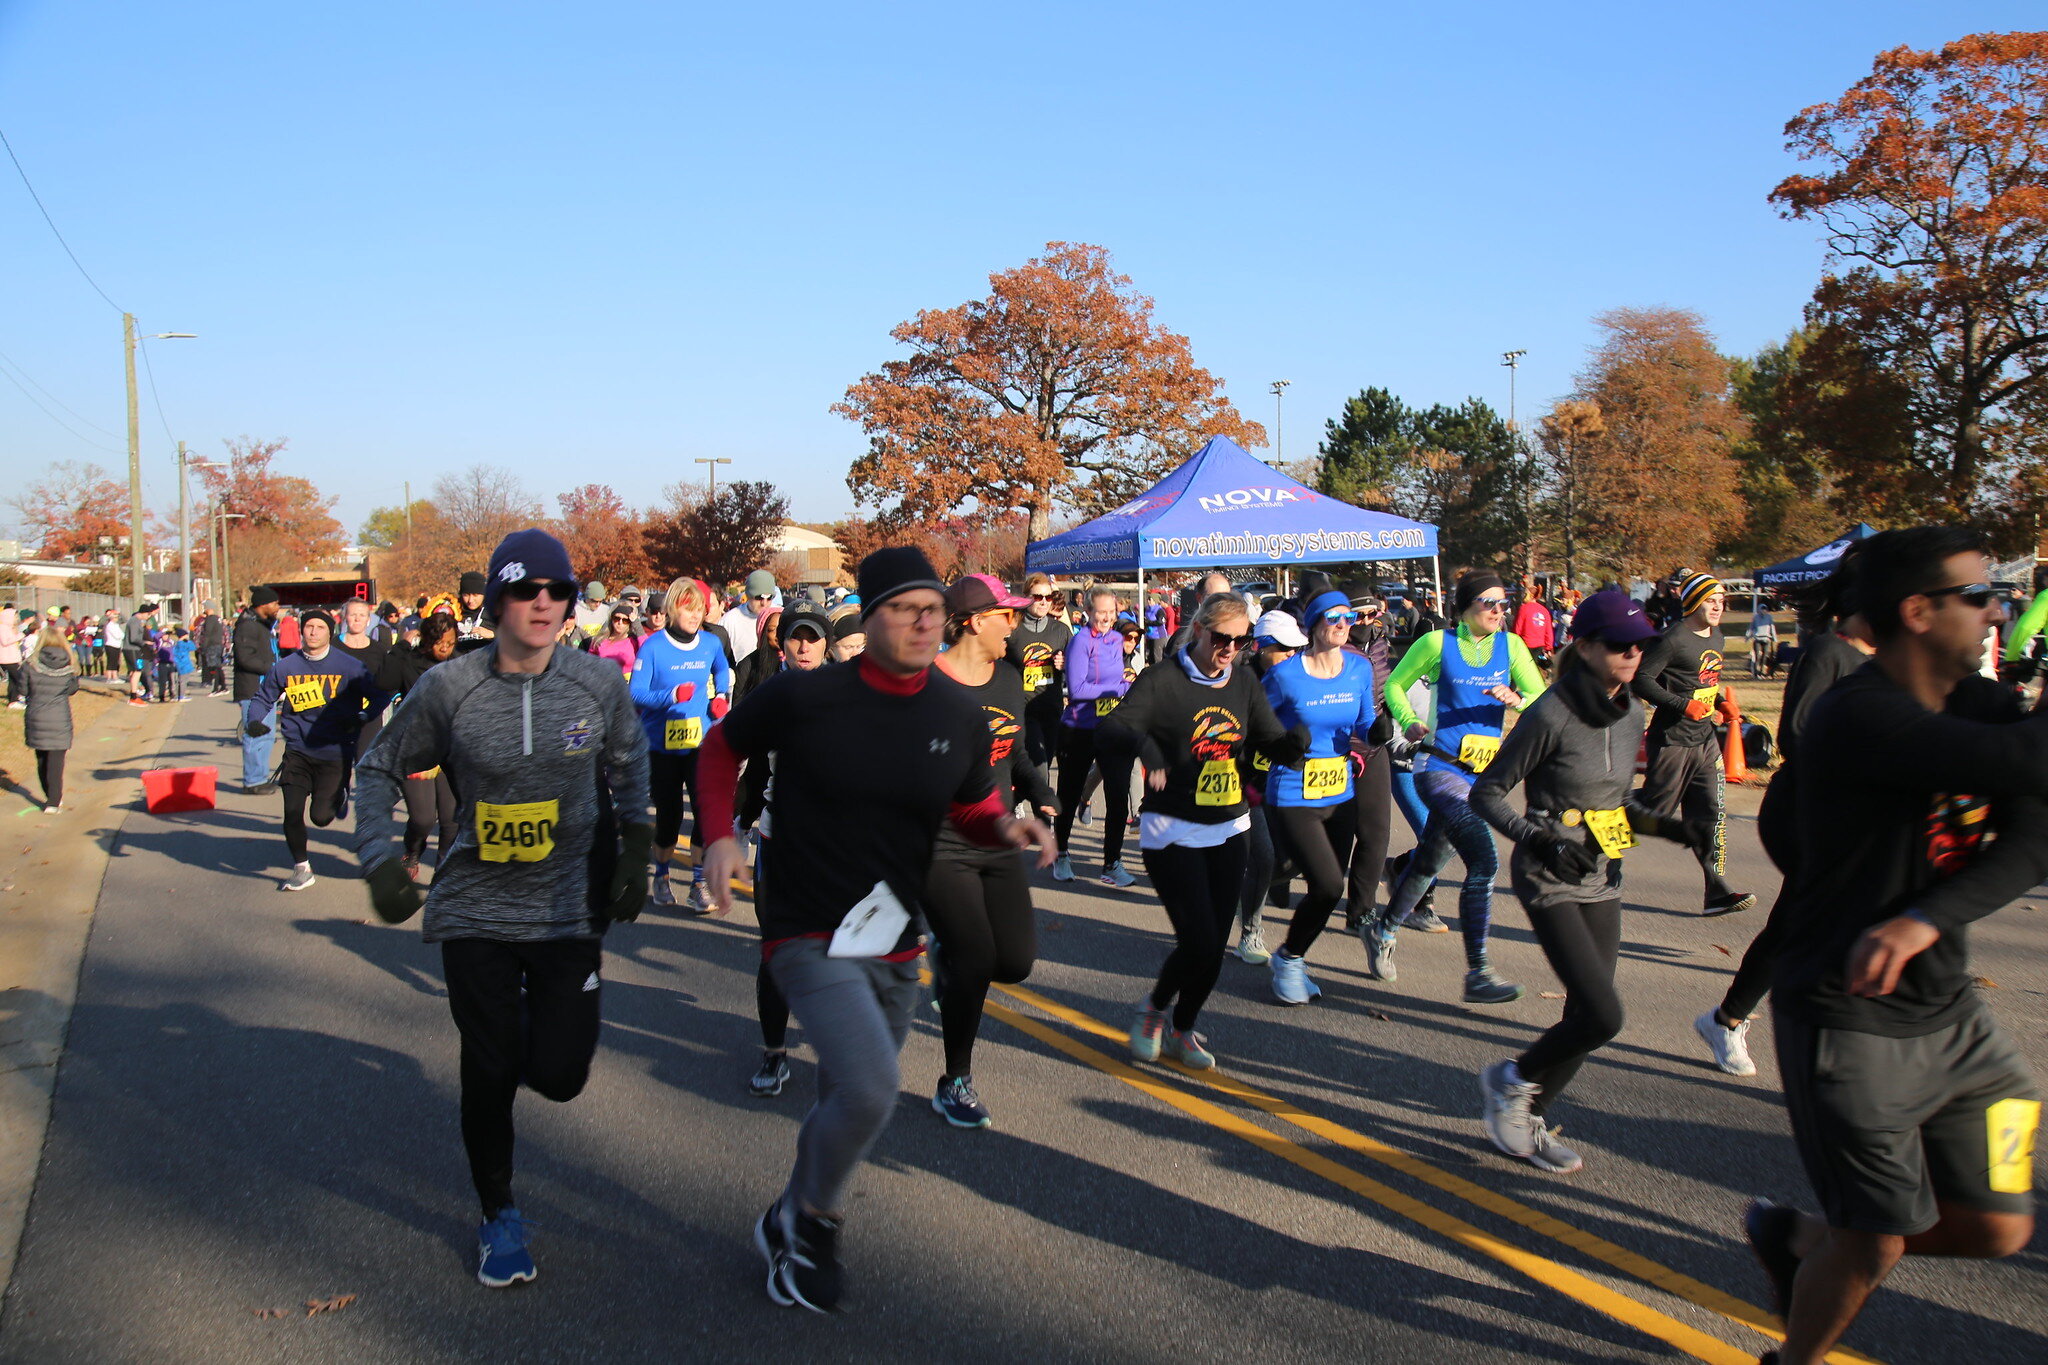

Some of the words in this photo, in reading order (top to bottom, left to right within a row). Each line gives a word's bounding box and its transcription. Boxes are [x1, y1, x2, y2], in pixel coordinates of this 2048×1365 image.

[1198, 488, 1300, 511] NOVA
[1152, 527, 1426, 560] novatimingsystems.com
[1762, 571, 1804, 584] PACKET
[290, 689, 319, 705] 2411
[1307, 768, 1345, 788] 2334
[483, 819, 552, 848] 2460
